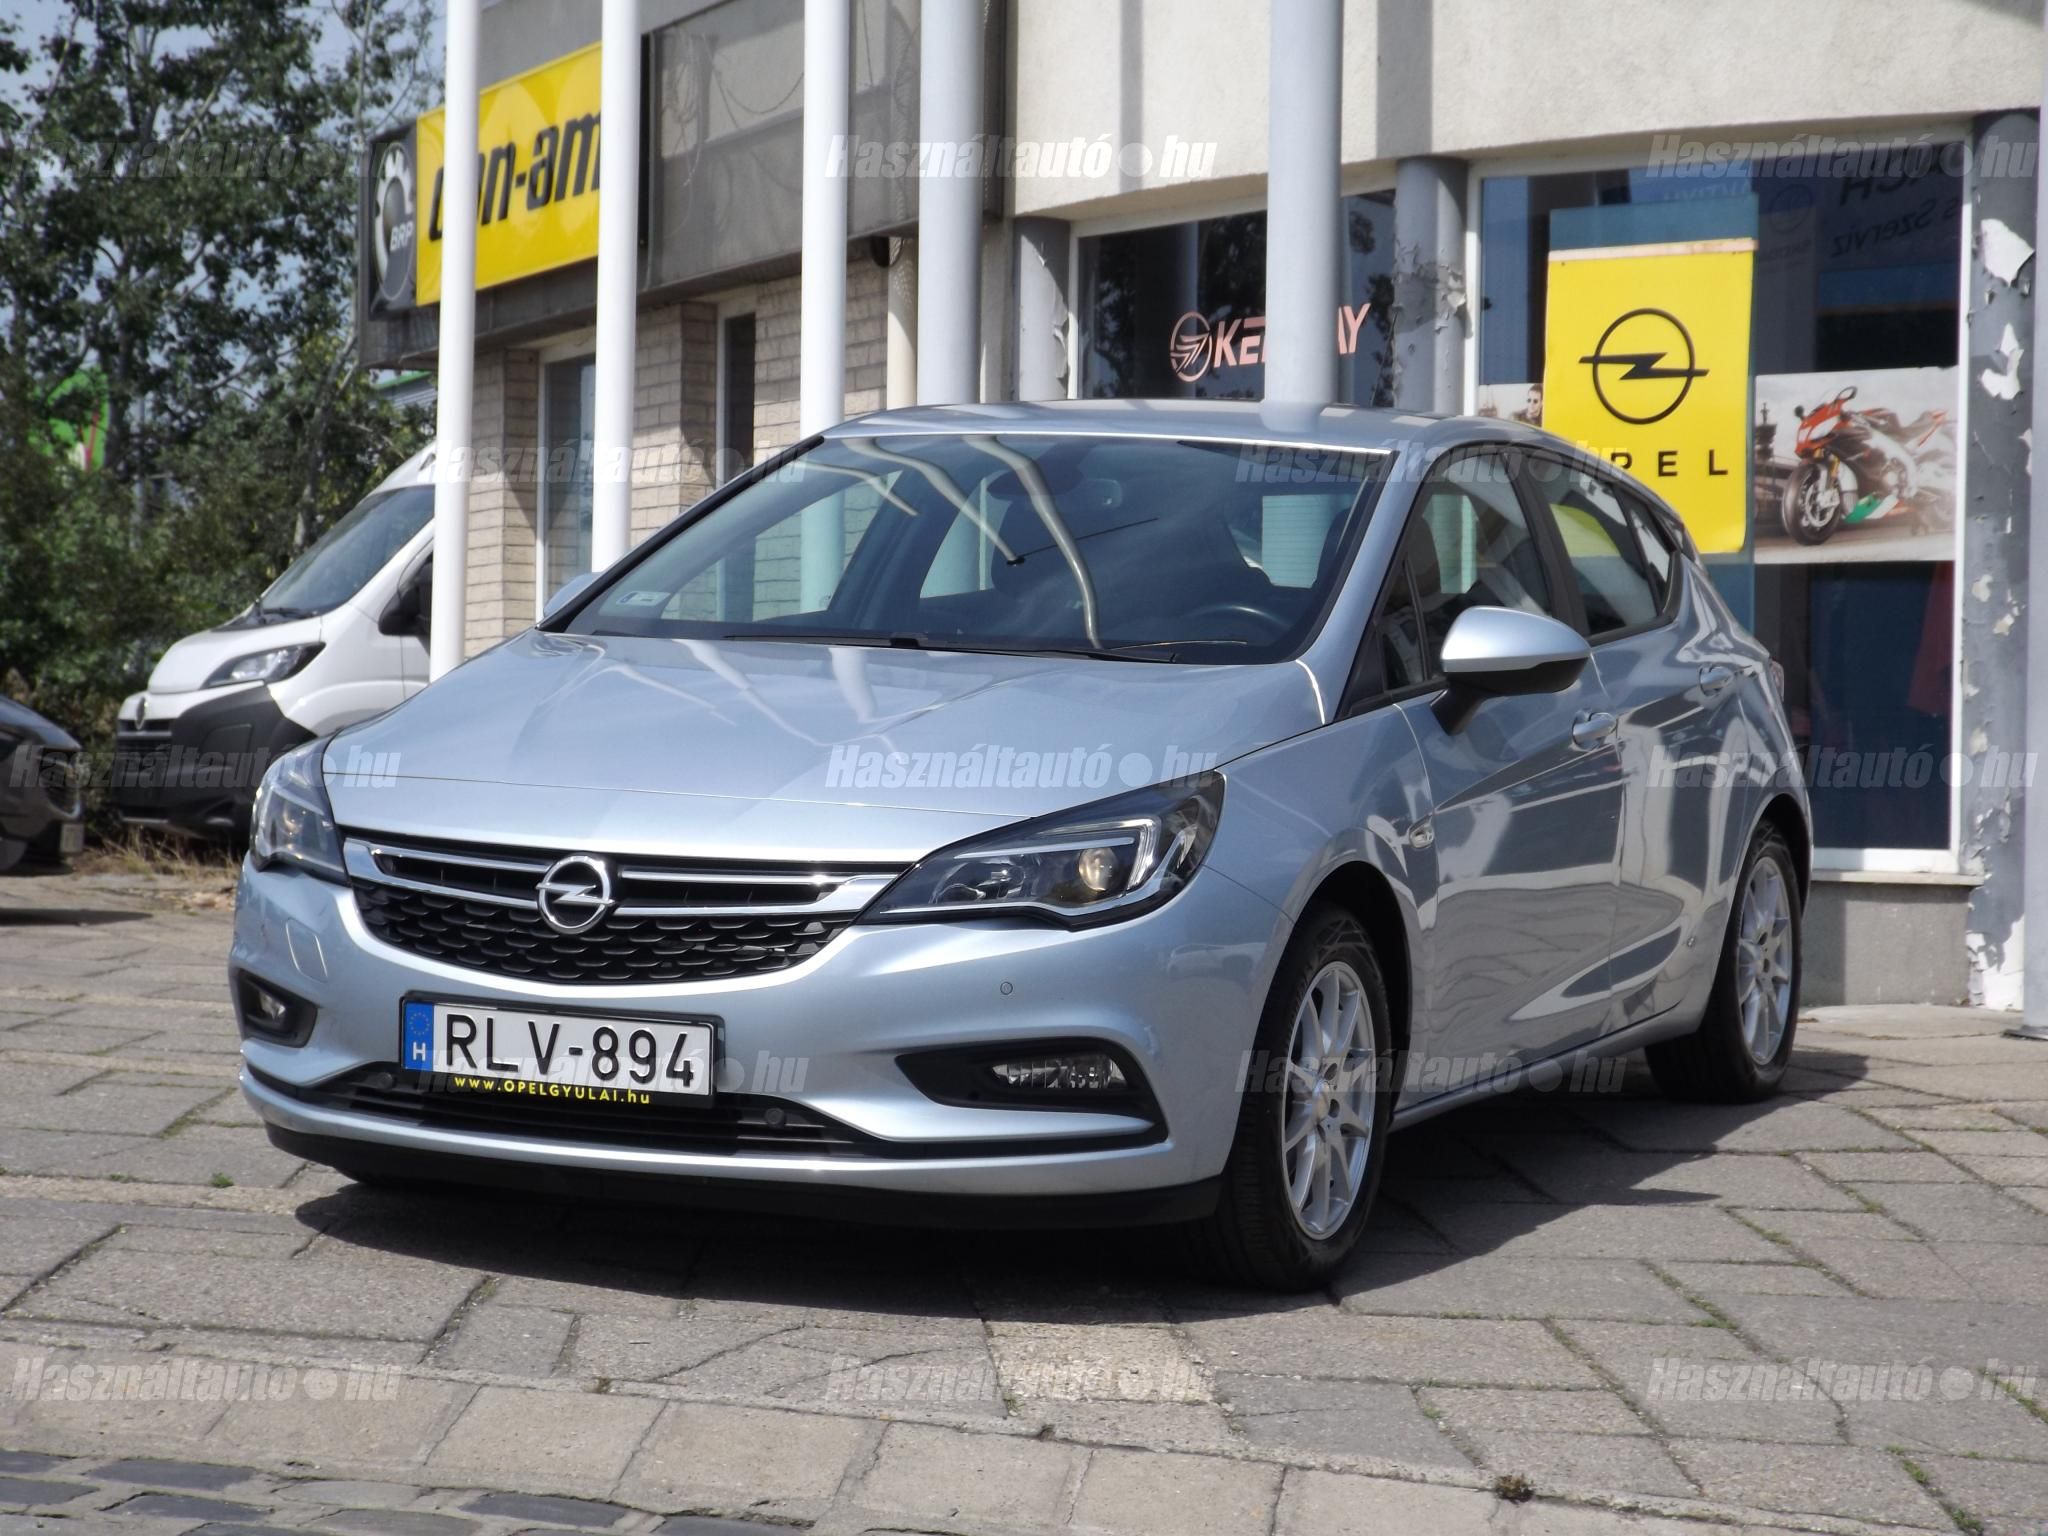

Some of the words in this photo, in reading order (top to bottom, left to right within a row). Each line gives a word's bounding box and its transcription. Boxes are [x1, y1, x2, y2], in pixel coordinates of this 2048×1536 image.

[429, 111, 600, 242] cn-am
[390, 221, 414, 252] BRP
[1610, 449, 1729, 477] PEL
[412, 1041, 426, 1061] H
[446, 1013, 694, 1087] RLV-894
[454, 1076, 650, 1104] www.OPELGYULAI.hu
